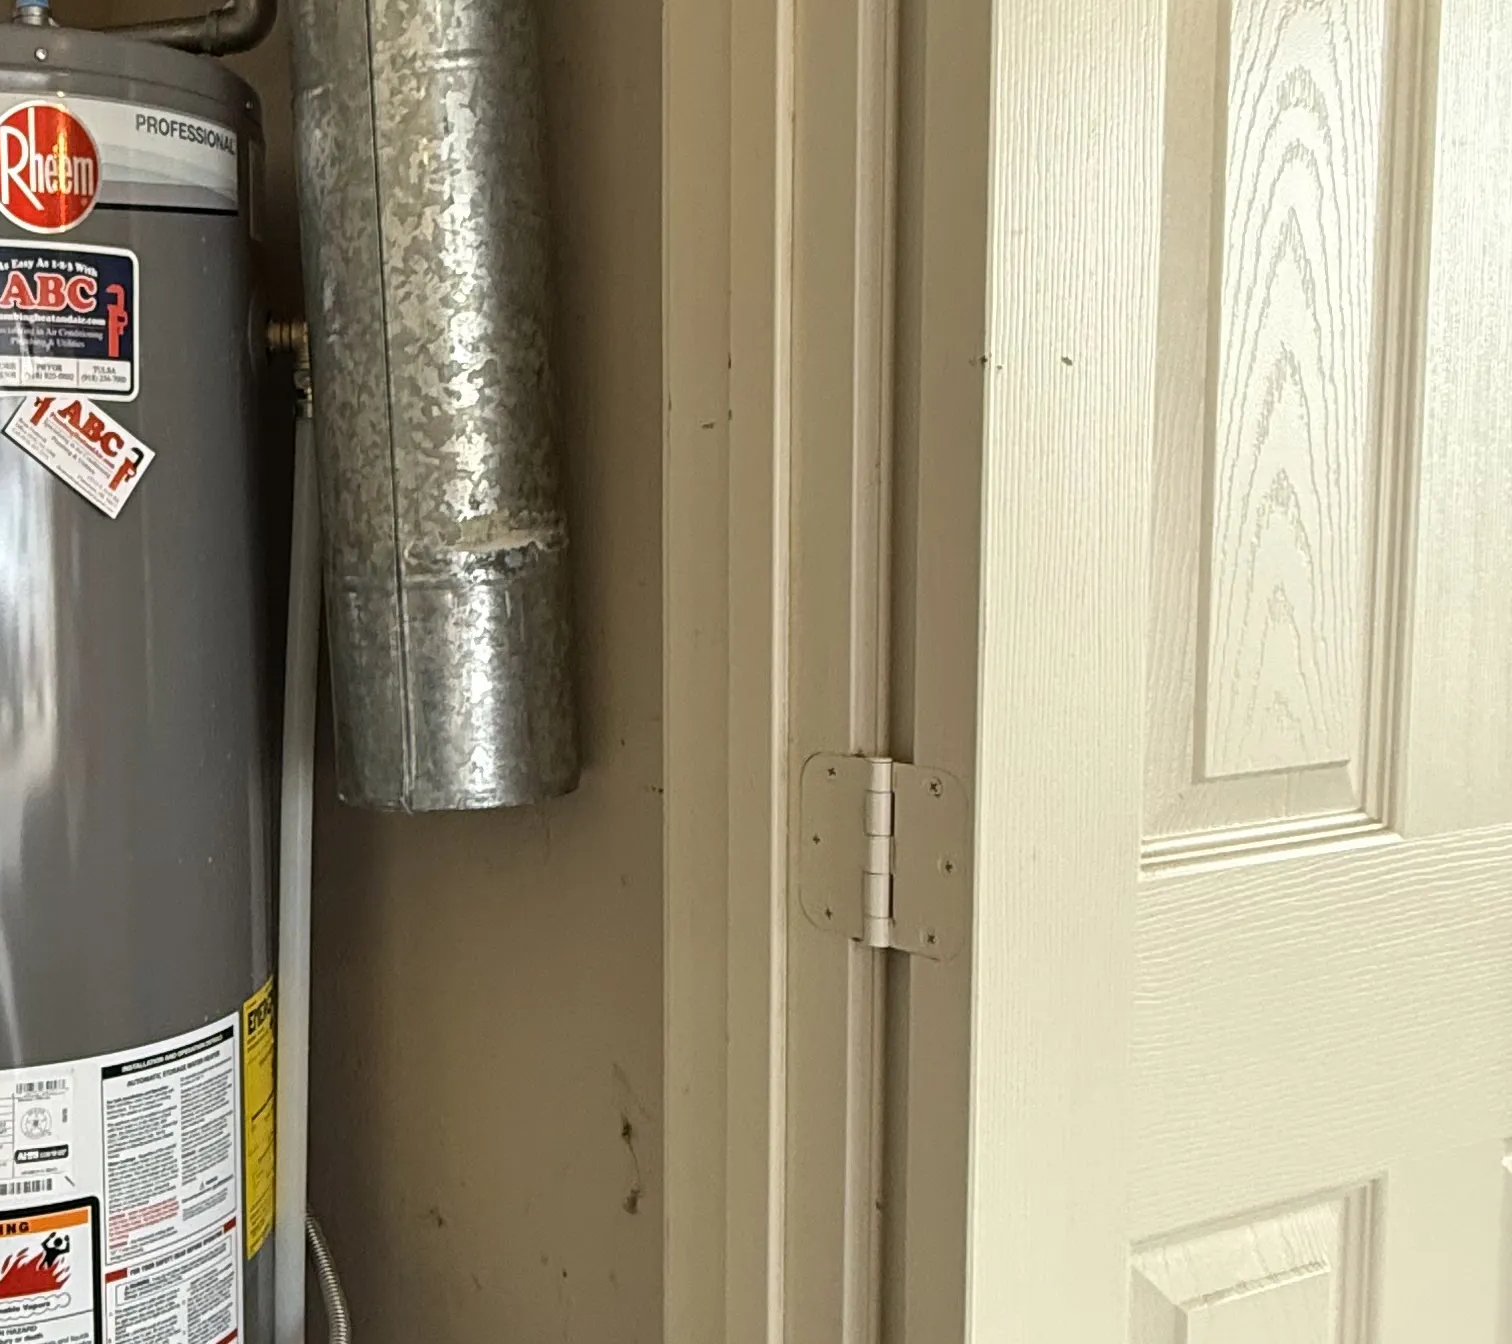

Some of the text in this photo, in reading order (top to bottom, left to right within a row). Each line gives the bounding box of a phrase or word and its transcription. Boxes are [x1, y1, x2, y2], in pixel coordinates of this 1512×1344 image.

[136, 113, 236, 154] PROFESSIONAL
[0, 107, 94, 211] Rheem
[11, 259, 34, 270] Easy
[36, 258, 49, 268] As
[57, 400, 124, 457] ABC
